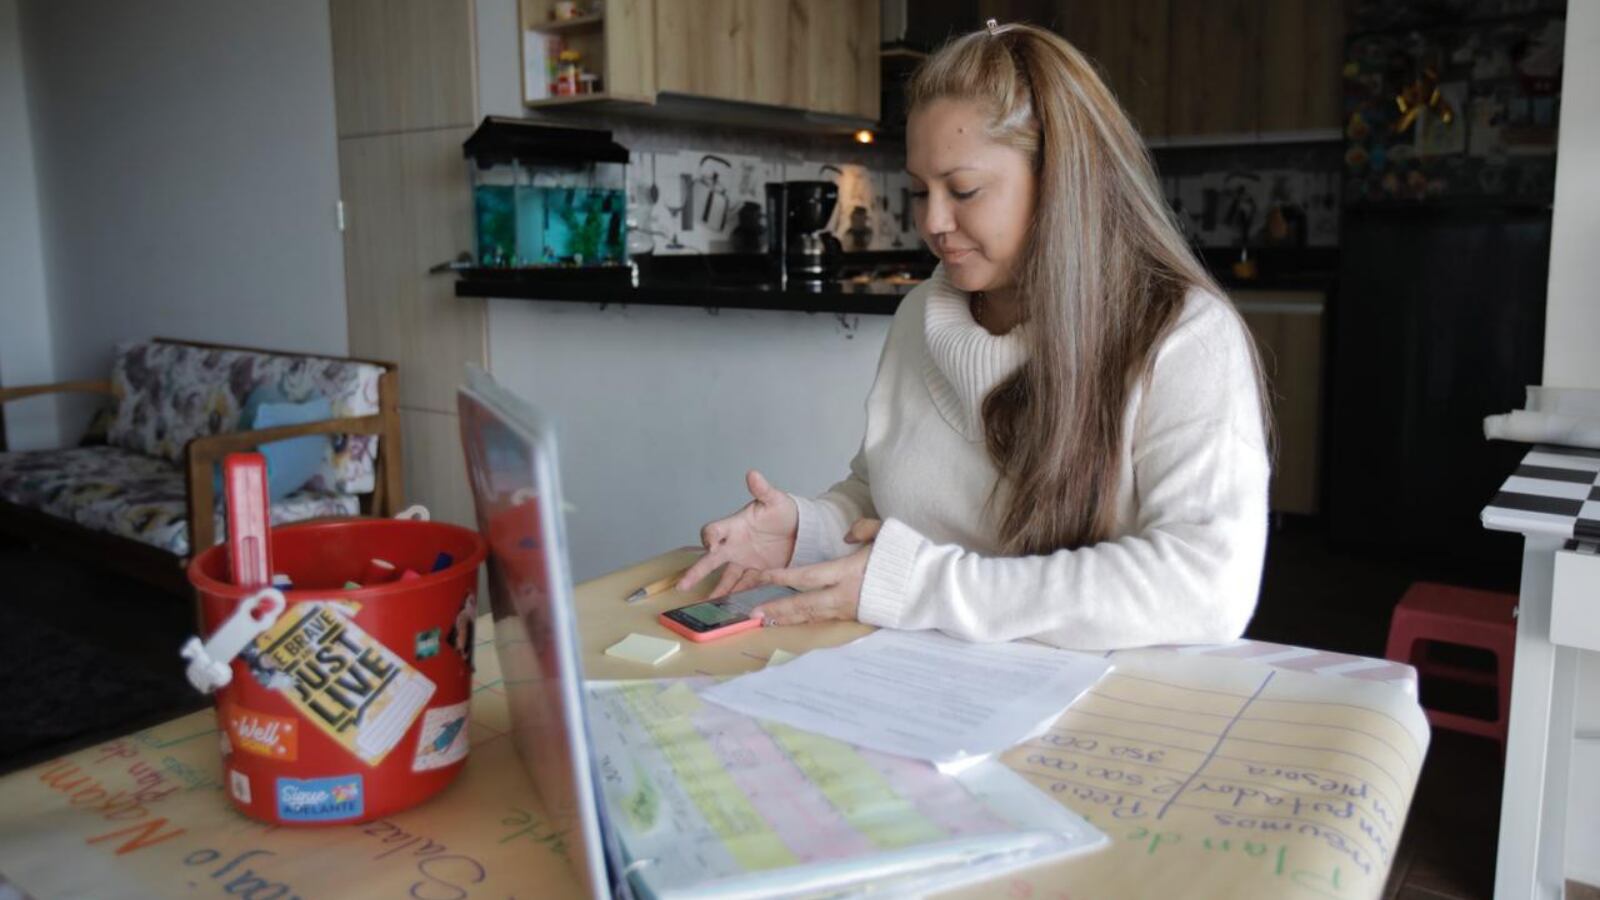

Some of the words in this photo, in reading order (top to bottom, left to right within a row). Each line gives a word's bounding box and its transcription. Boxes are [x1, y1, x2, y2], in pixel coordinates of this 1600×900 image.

[284, 608, 336, 658] BRAVE
[294, 629, 364, 702] JUST
[309, 648, 395, 727] LIVE
[238, 715, 281, 746] Well
[281, 784, 330, 811] Sigue
[1051, 782, 1149, 819] Precio
